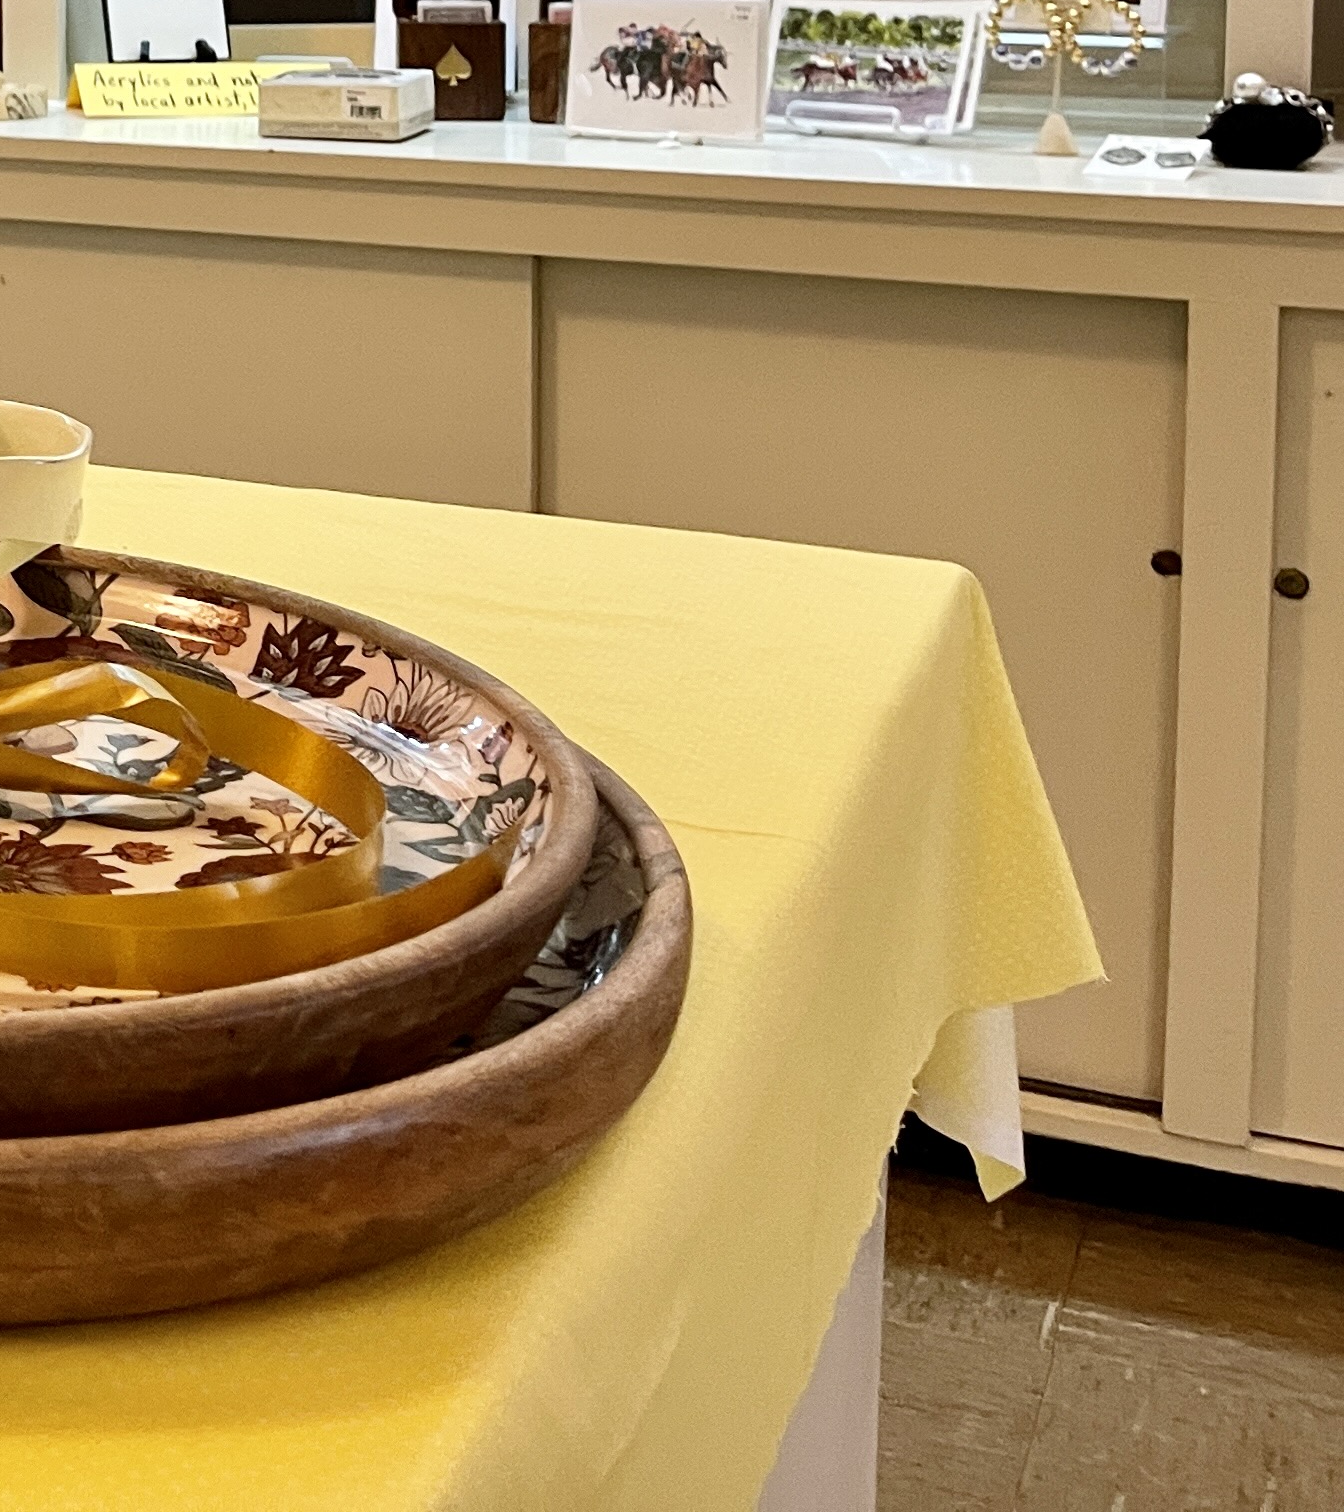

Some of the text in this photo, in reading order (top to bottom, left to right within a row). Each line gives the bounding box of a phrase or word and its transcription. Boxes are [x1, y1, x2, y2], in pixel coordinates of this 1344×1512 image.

[93, 69, 171, 96] Acrylics
[185, 71, 220, 90] and
[102, 93, 125, 112] by
[132, 92, 177, 110] local
[183, 92, 248, 112] artist,
